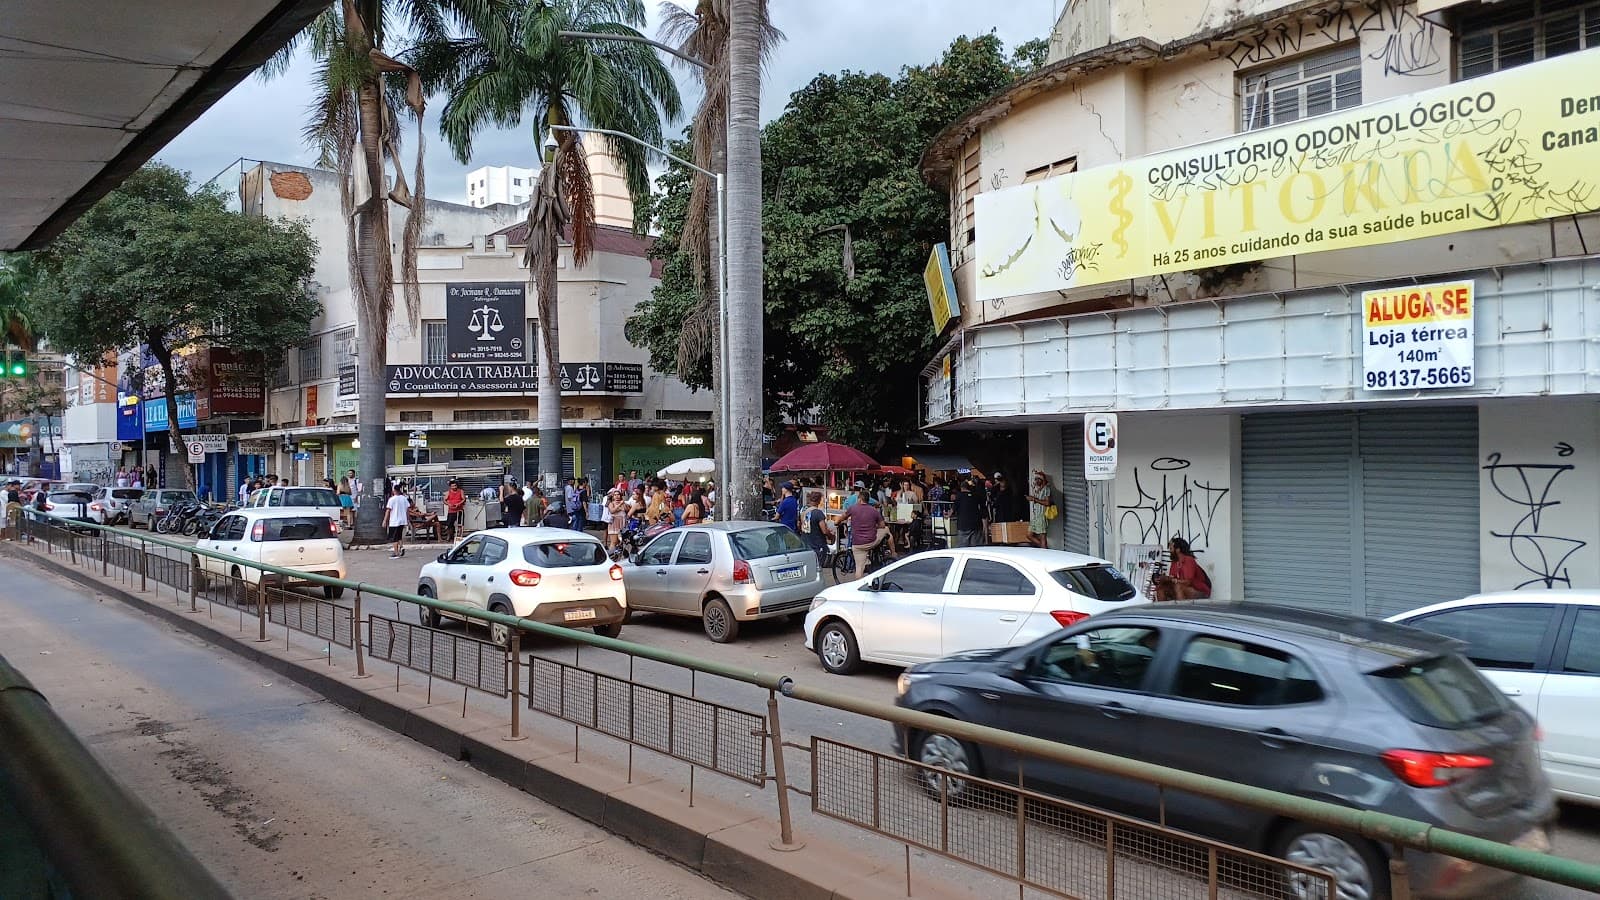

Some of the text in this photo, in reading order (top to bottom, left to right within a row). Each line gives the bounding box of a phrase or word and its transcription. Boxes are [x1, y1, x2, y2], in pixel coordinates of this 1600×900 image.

[1148, 138, 1288, 185] CONSULTÓRIO
[1295, 91, 1496, 153] ODONTOLÓGICO
[1542, 126, 1600, 151] Cana
[1153, 203, 1470, 267] Há 25 anos cuidando da sua saúde bucal
[1369, 288, 1468, 322] ALUGA-SE
[1369, 326, 1468, 348] Loja térrea
[393, 365, 569, 380] ADVOCACIA TRABALHA
[1366, 366, 1472, 388] 98137-5665
[404, 381, 459, 391] Consultoria
[468, 381, 518, 390] Assessoria
[1095, 422, 1106, 446] E
[193, 444, 199, 453] E
